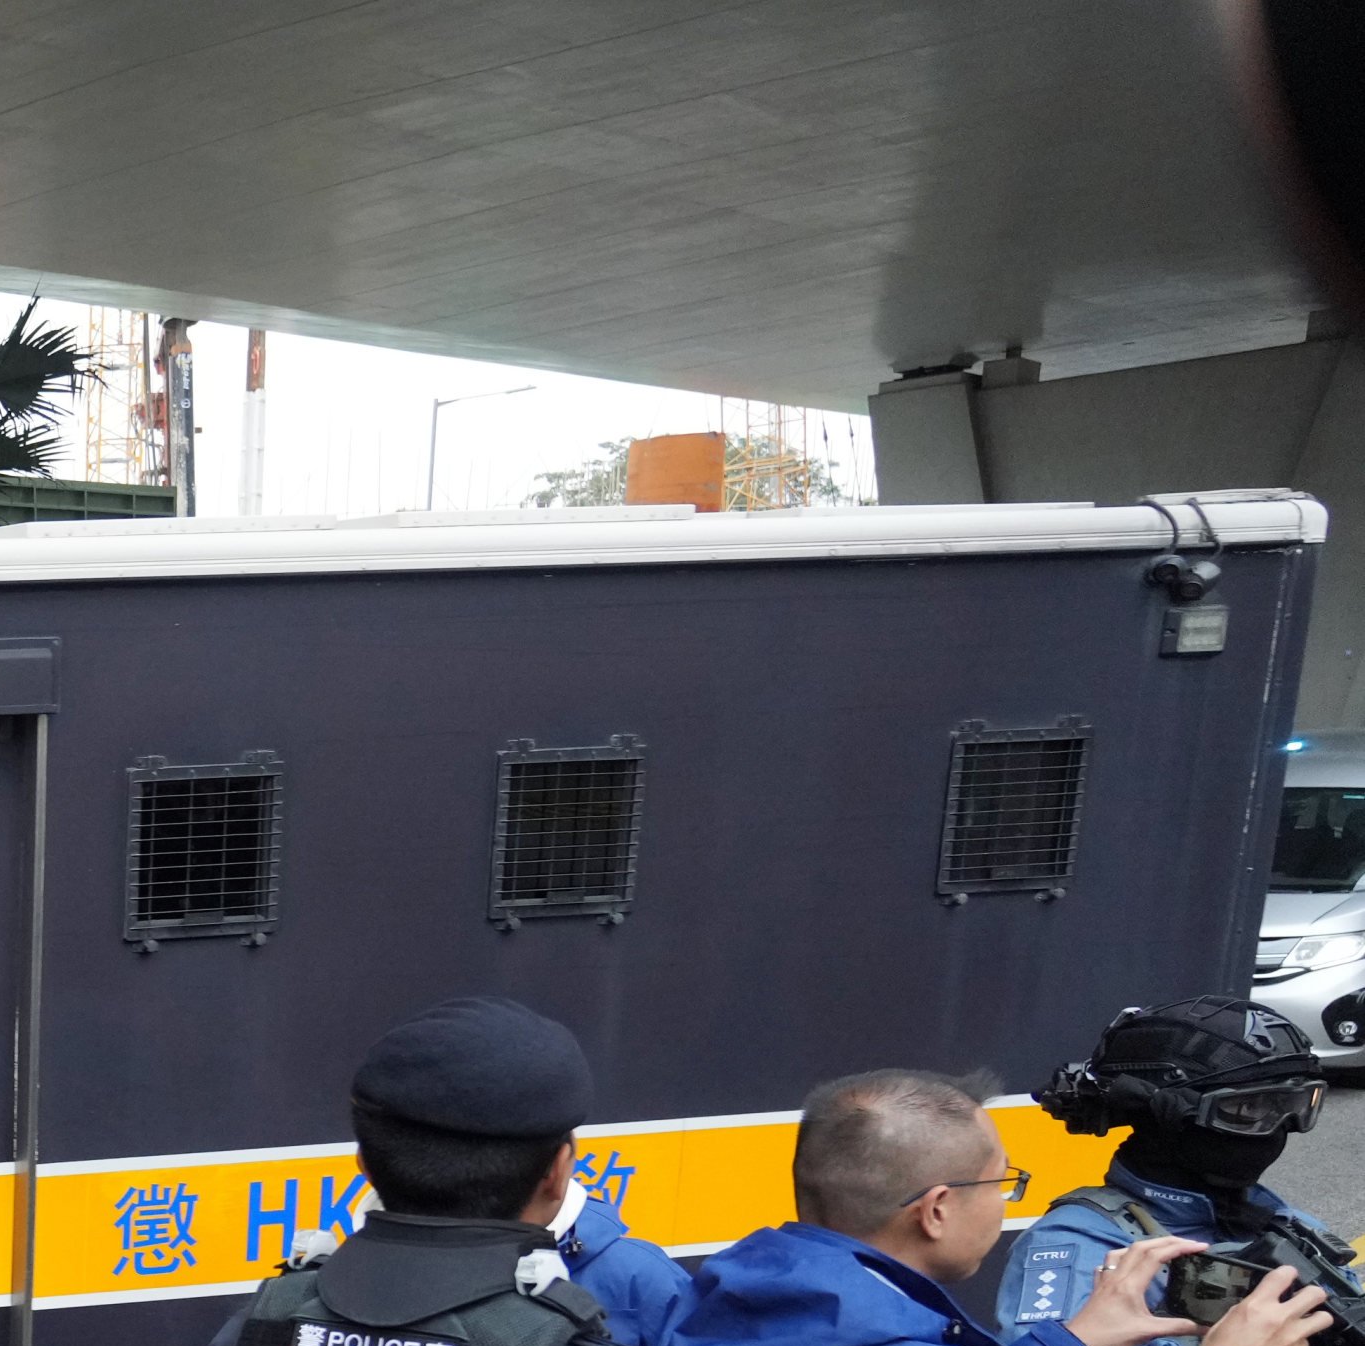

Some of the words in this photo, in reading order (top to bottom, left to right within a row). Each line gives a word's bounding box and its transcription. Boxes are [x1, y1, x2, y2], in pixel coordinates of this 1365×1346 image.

[113, 1181, 200, 1277] 懲
[245, 1173, 367, 1262] HK
[1032, 1250, 1069, 1261] CTRU
